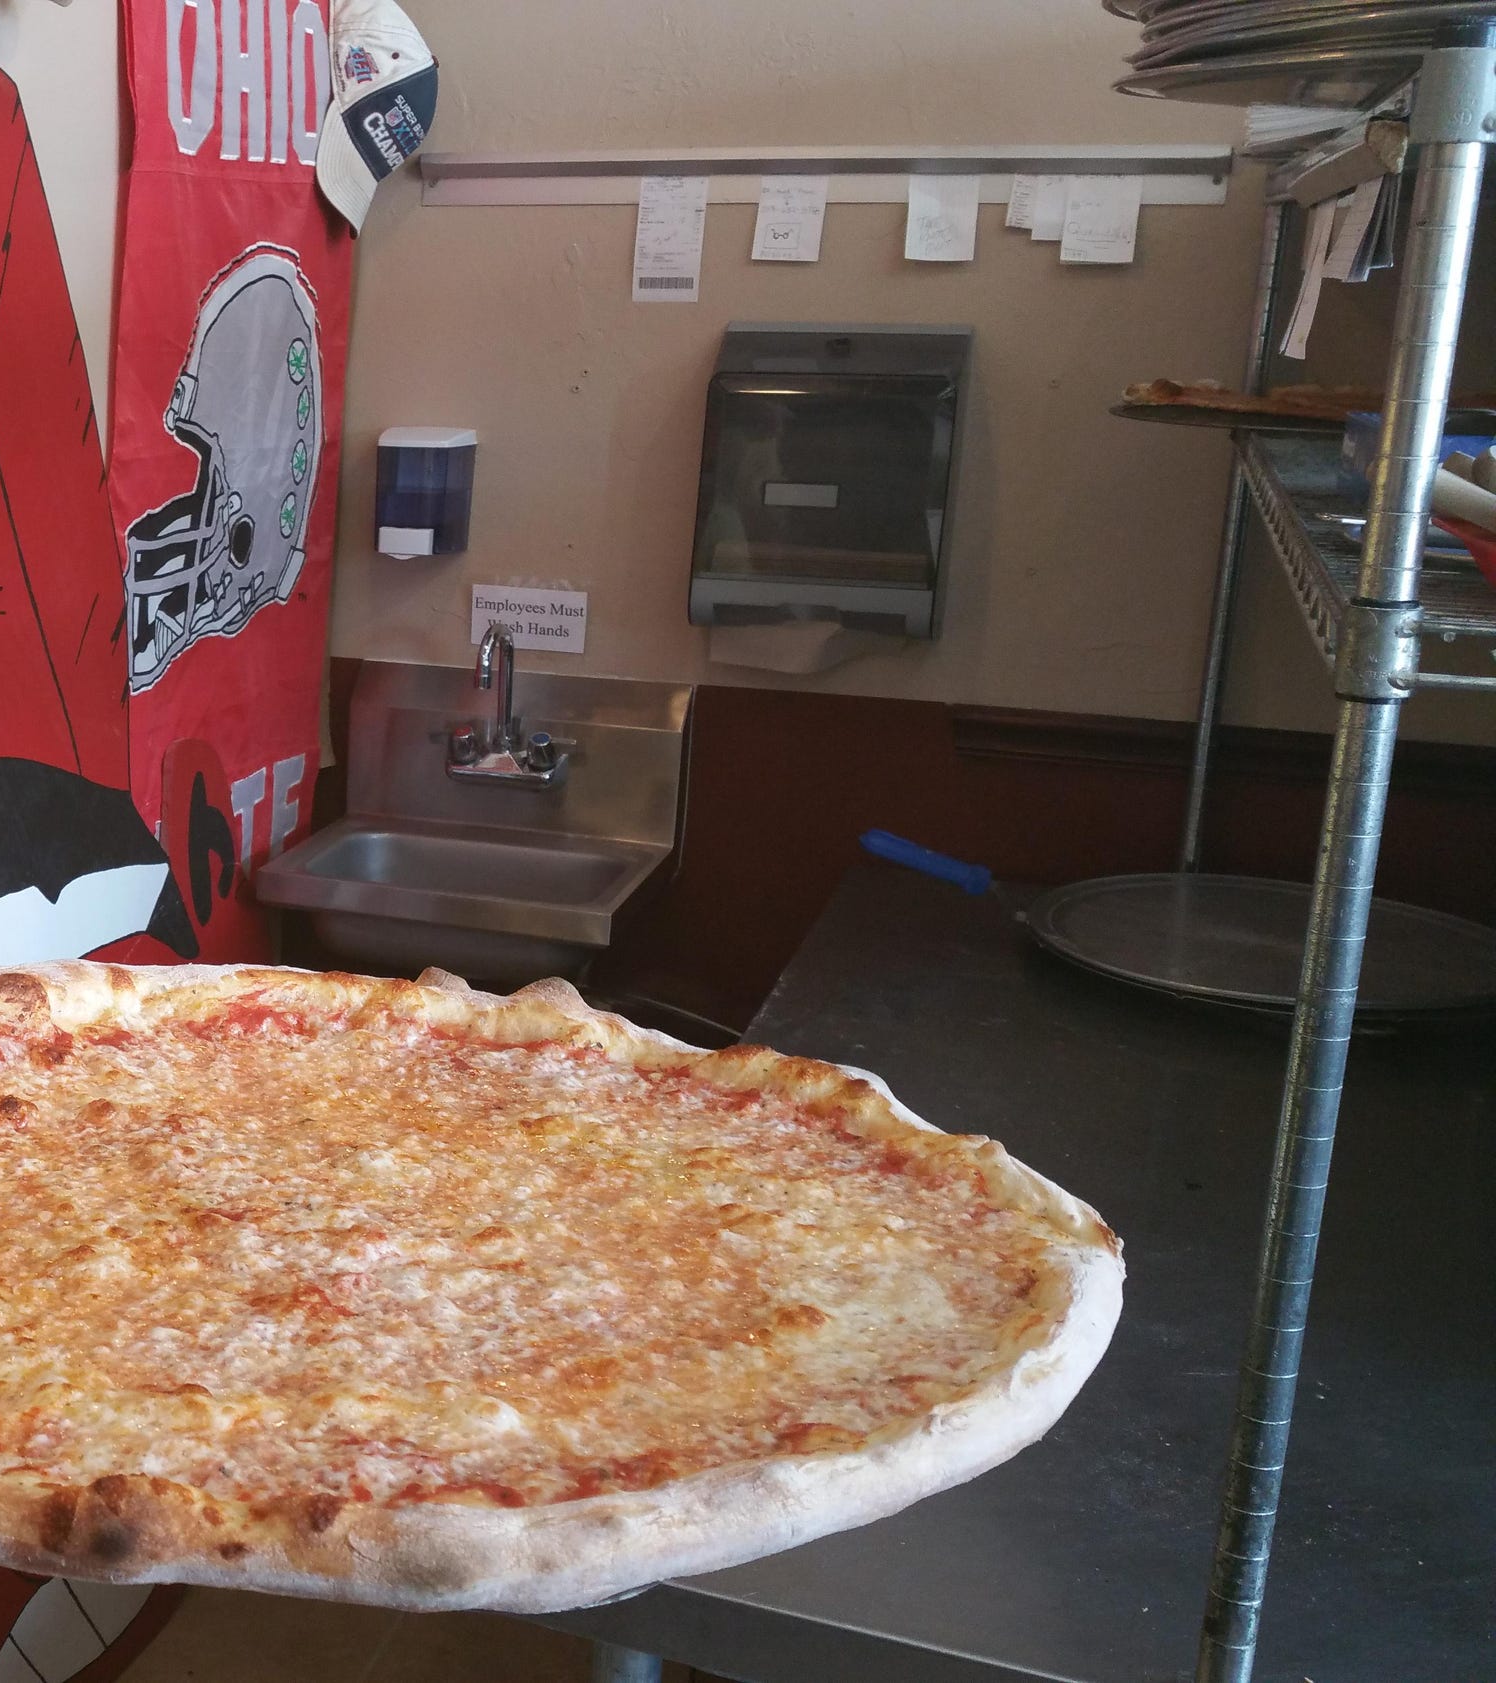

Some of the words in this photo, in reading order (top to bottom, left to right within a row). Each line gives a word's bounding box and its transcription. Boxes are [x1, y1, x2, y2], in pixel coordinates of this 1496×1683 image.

[165, 0, 331, 167] OHIO
[394, 94, 418, 125] SUPER
[475, 596, 546, 616] Employees
[549, 602, 584, 617] Must
[488, 619, 524, 634] sh
[528, 622, 569, 638] Hands
